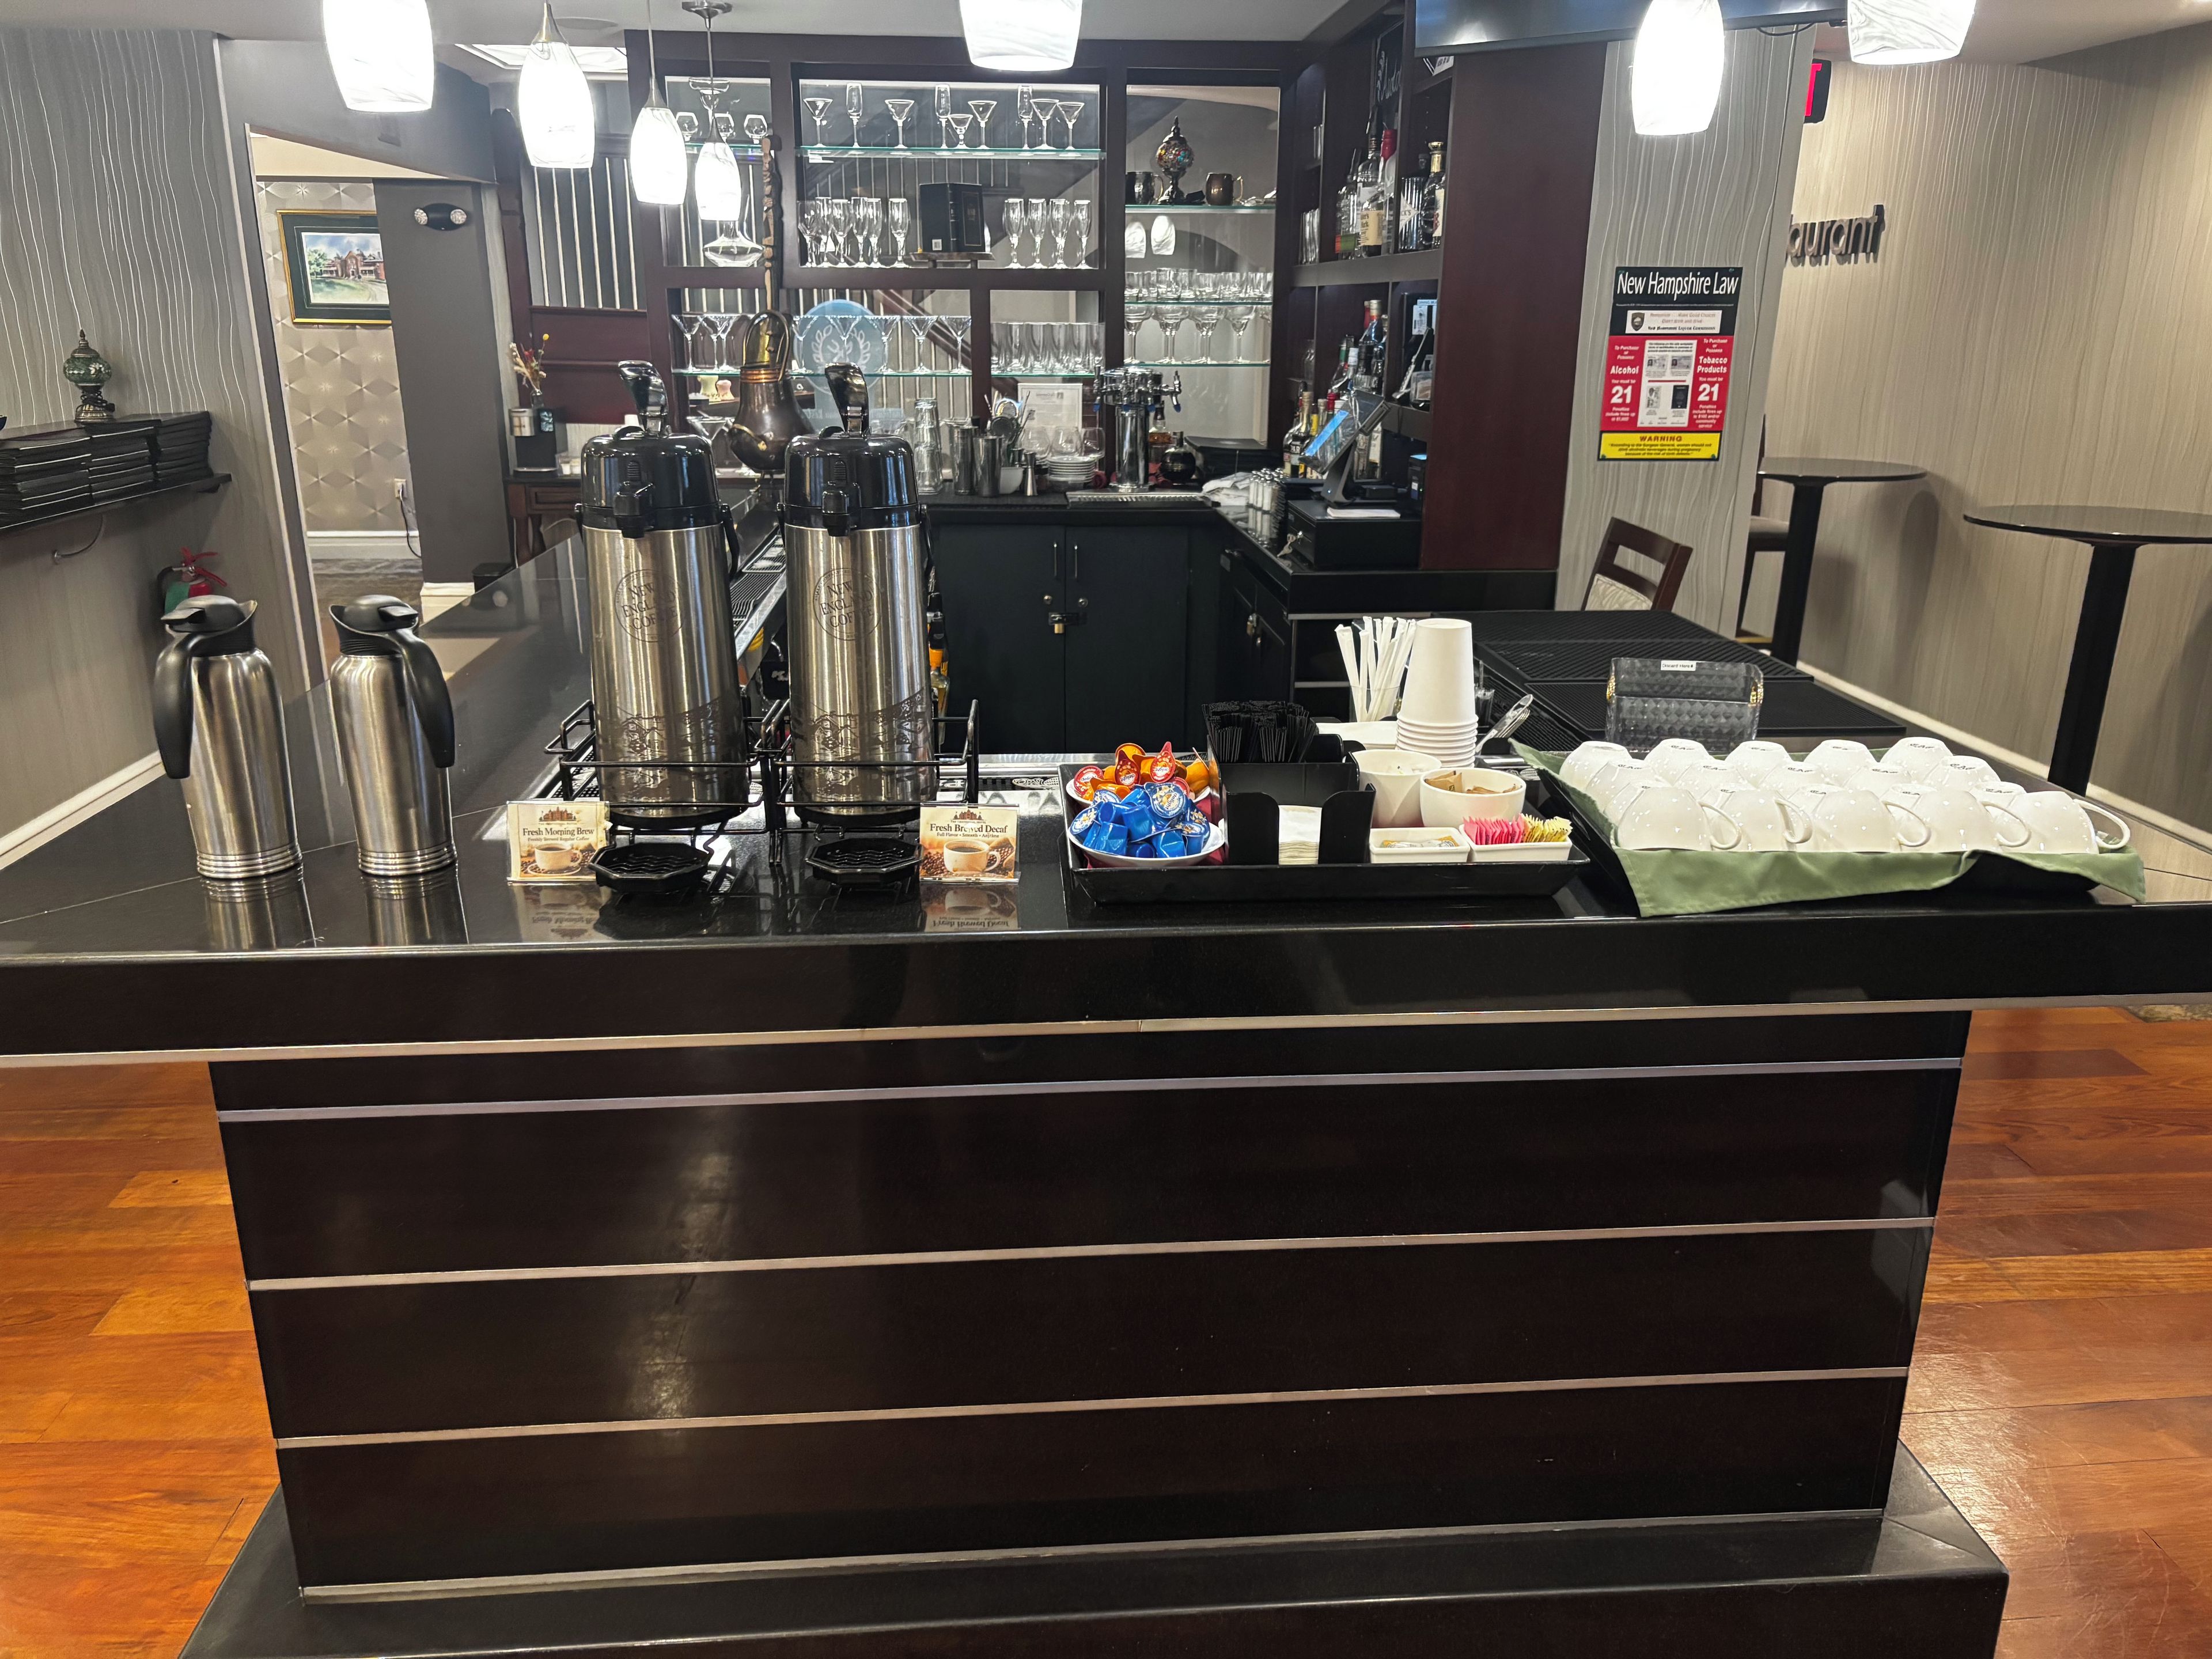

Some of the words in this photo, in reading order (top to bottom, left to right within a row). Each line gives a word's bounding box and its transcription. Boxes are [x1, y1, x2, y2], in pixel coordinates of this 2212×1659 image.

[1787, 204, 1885, 256] aurant
[1617, 272, 1646, 294] New
[1647, 272, 1711, 301] Hampshire
[1713, 272, 1739, 294] Law
[1699, 356, 1728, 364] Tobacco
[1610, 365, 1639, 374] Alcohol
[1697, 365, 1727, 373] Products
[1610, 385, 1633, 404] 21
[1697, 383, 1719, 402] 21
[628, 582, 655, 599] NEW
[827, 581, 853, 597] NEW
[622, 592, 676, 617] ENGLD
[821, 591, 873, 615] ENGLD
[632, 607, 678, 630] COFE
[830, 606, 874, 627] COFE
[1120, 773, 1135, 782] delight
[1165, 793, 1177, 810] delight
[545, 828, 575, 836] Morning
[930, 823, 952, 832] Fresh
[985, 825, 1008, 833] Decaf
